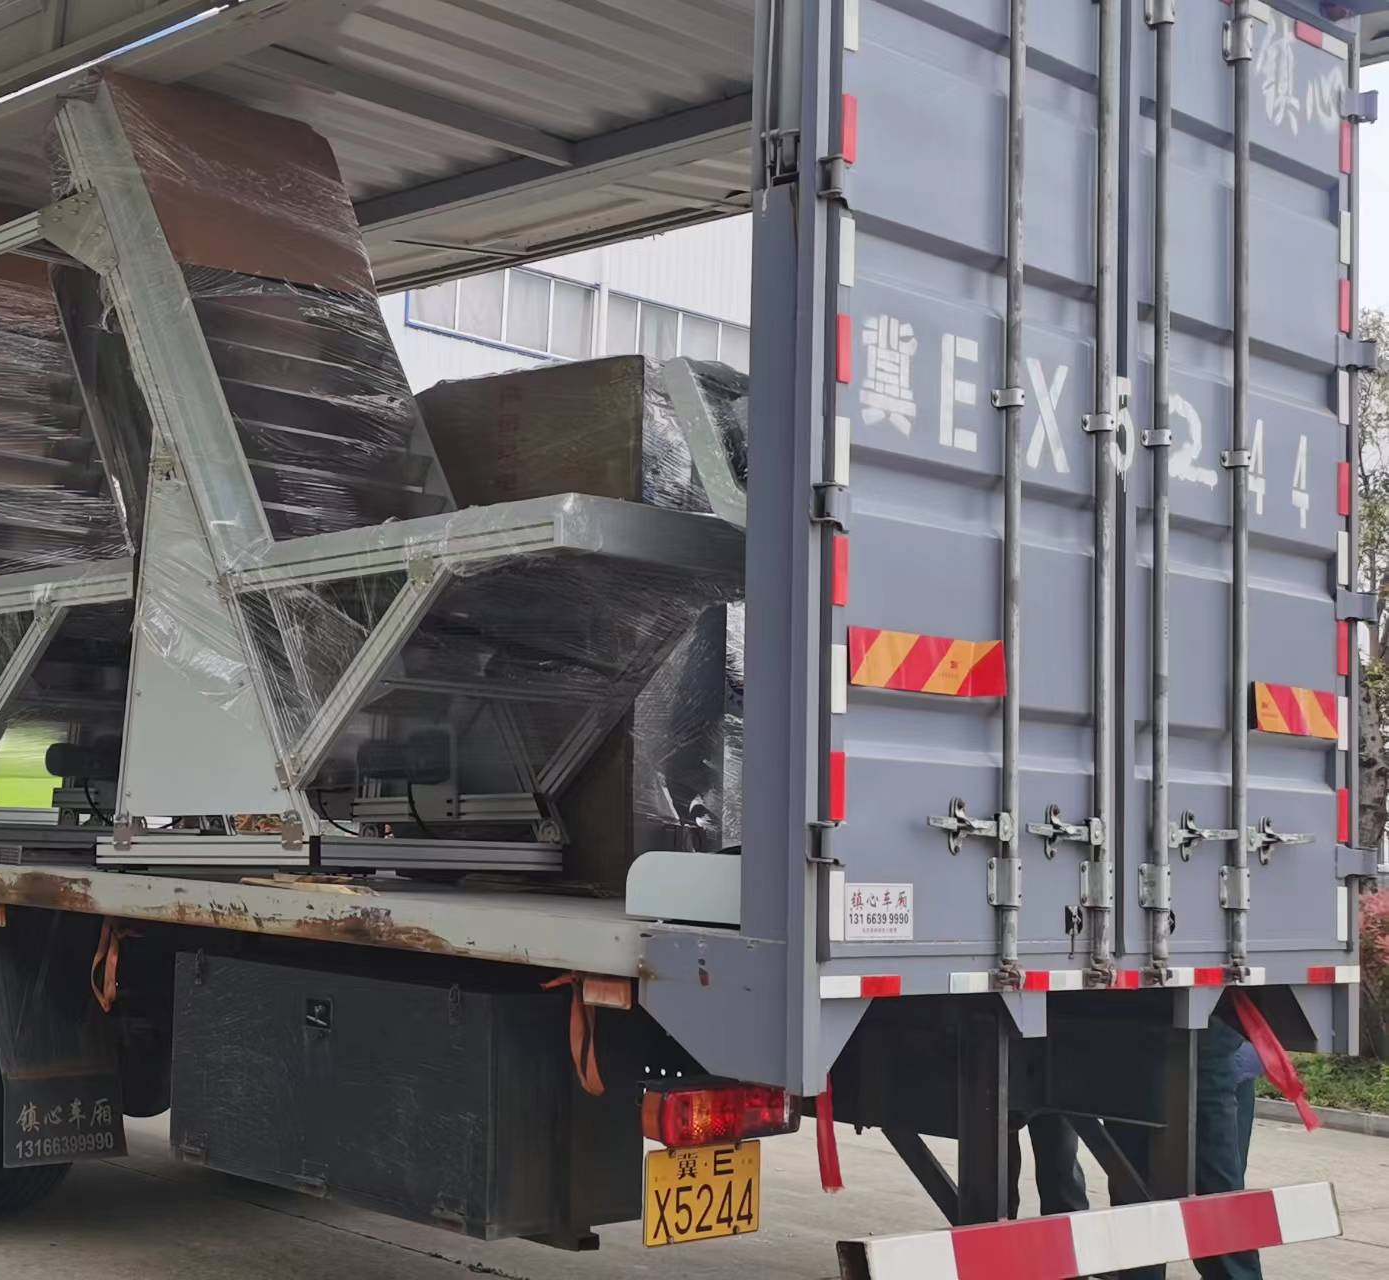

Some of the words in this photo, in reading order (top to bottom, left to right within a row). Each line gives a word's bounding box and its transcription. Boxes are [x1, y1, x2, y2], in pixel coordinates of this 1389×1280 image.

[849, 913, 864, 925] 131
[866, 913, 887, 925] 6639
[889, 913, 909, 925] 9990
[16, 1098, 111, 1132] 镇心车厢
[15, 1132, 114, 1159] 13166399990
[653, 1177, 753, 1239] X5244
